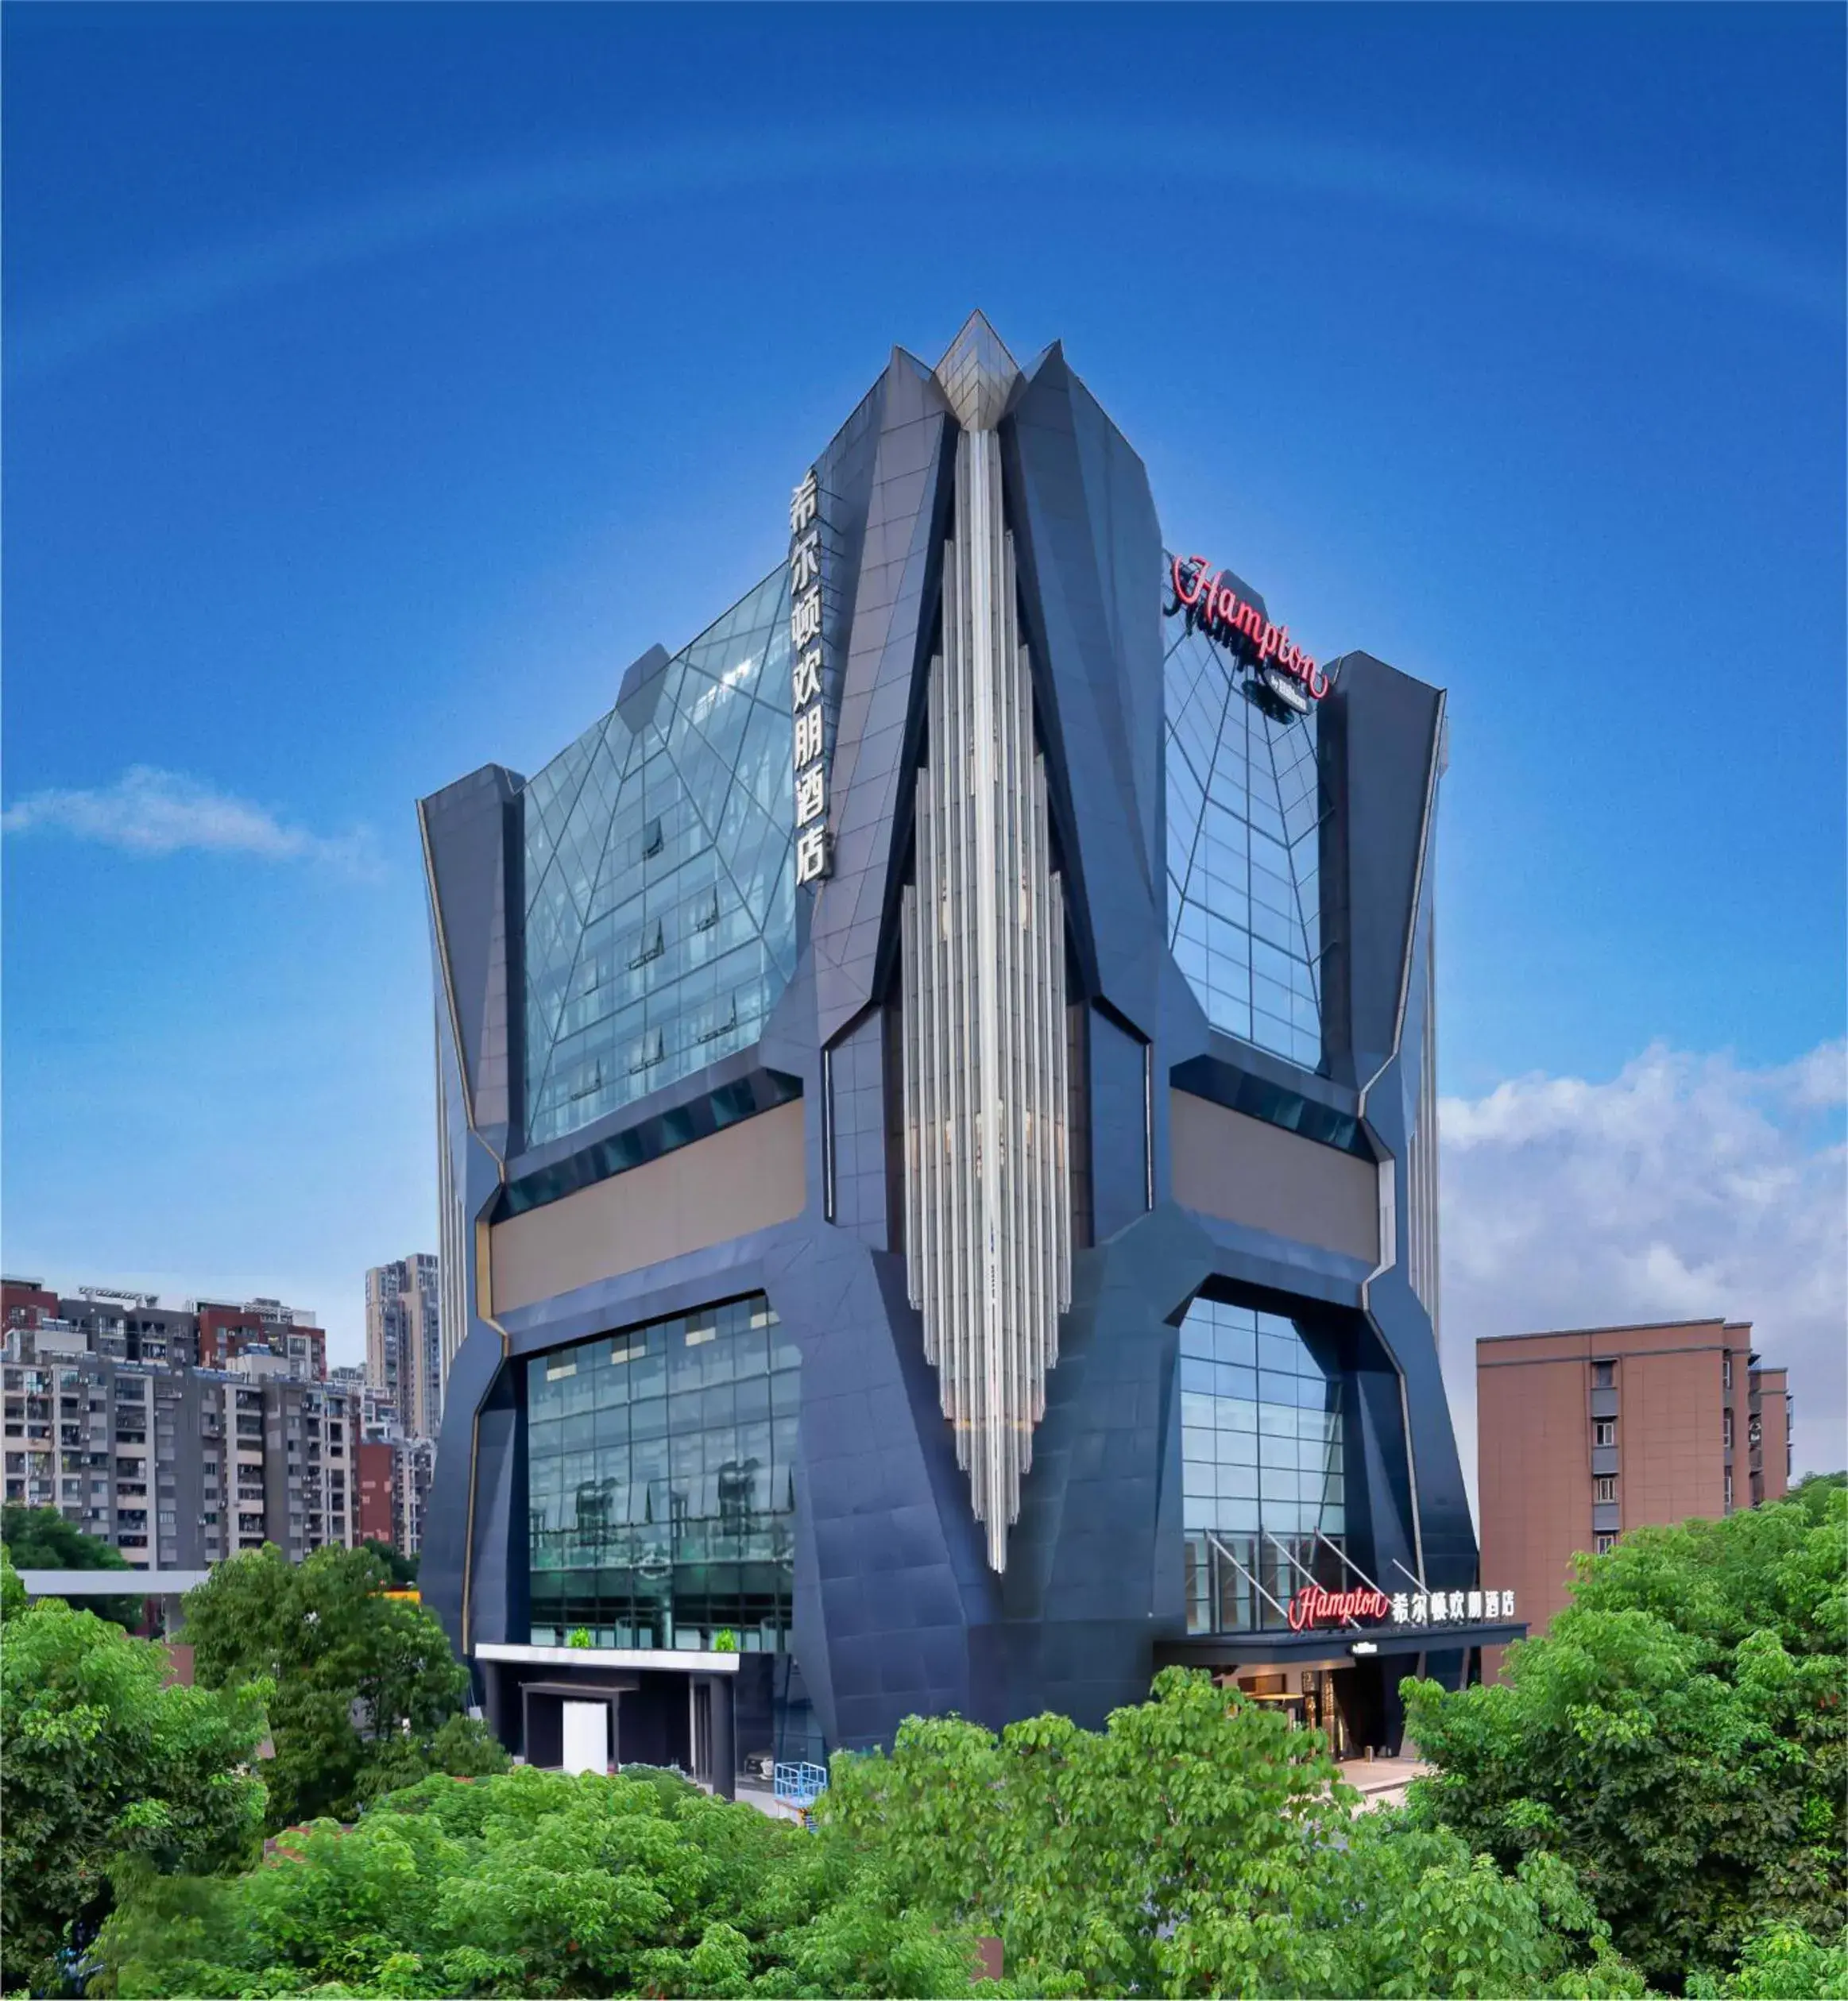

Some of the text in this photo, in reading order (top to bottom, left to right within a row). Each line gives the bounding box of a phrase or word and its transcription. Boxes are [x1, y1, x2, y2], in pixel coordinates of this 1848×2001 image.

[1172, 555, 1329, 699] Hampton
[790, 468, 825, 886] 希尔顿欢朋酒店
[1289, 1584, 1387, 1628] Hampton
[1393, 1590, 1514, 1623] 希尔顿欢朋酒店
